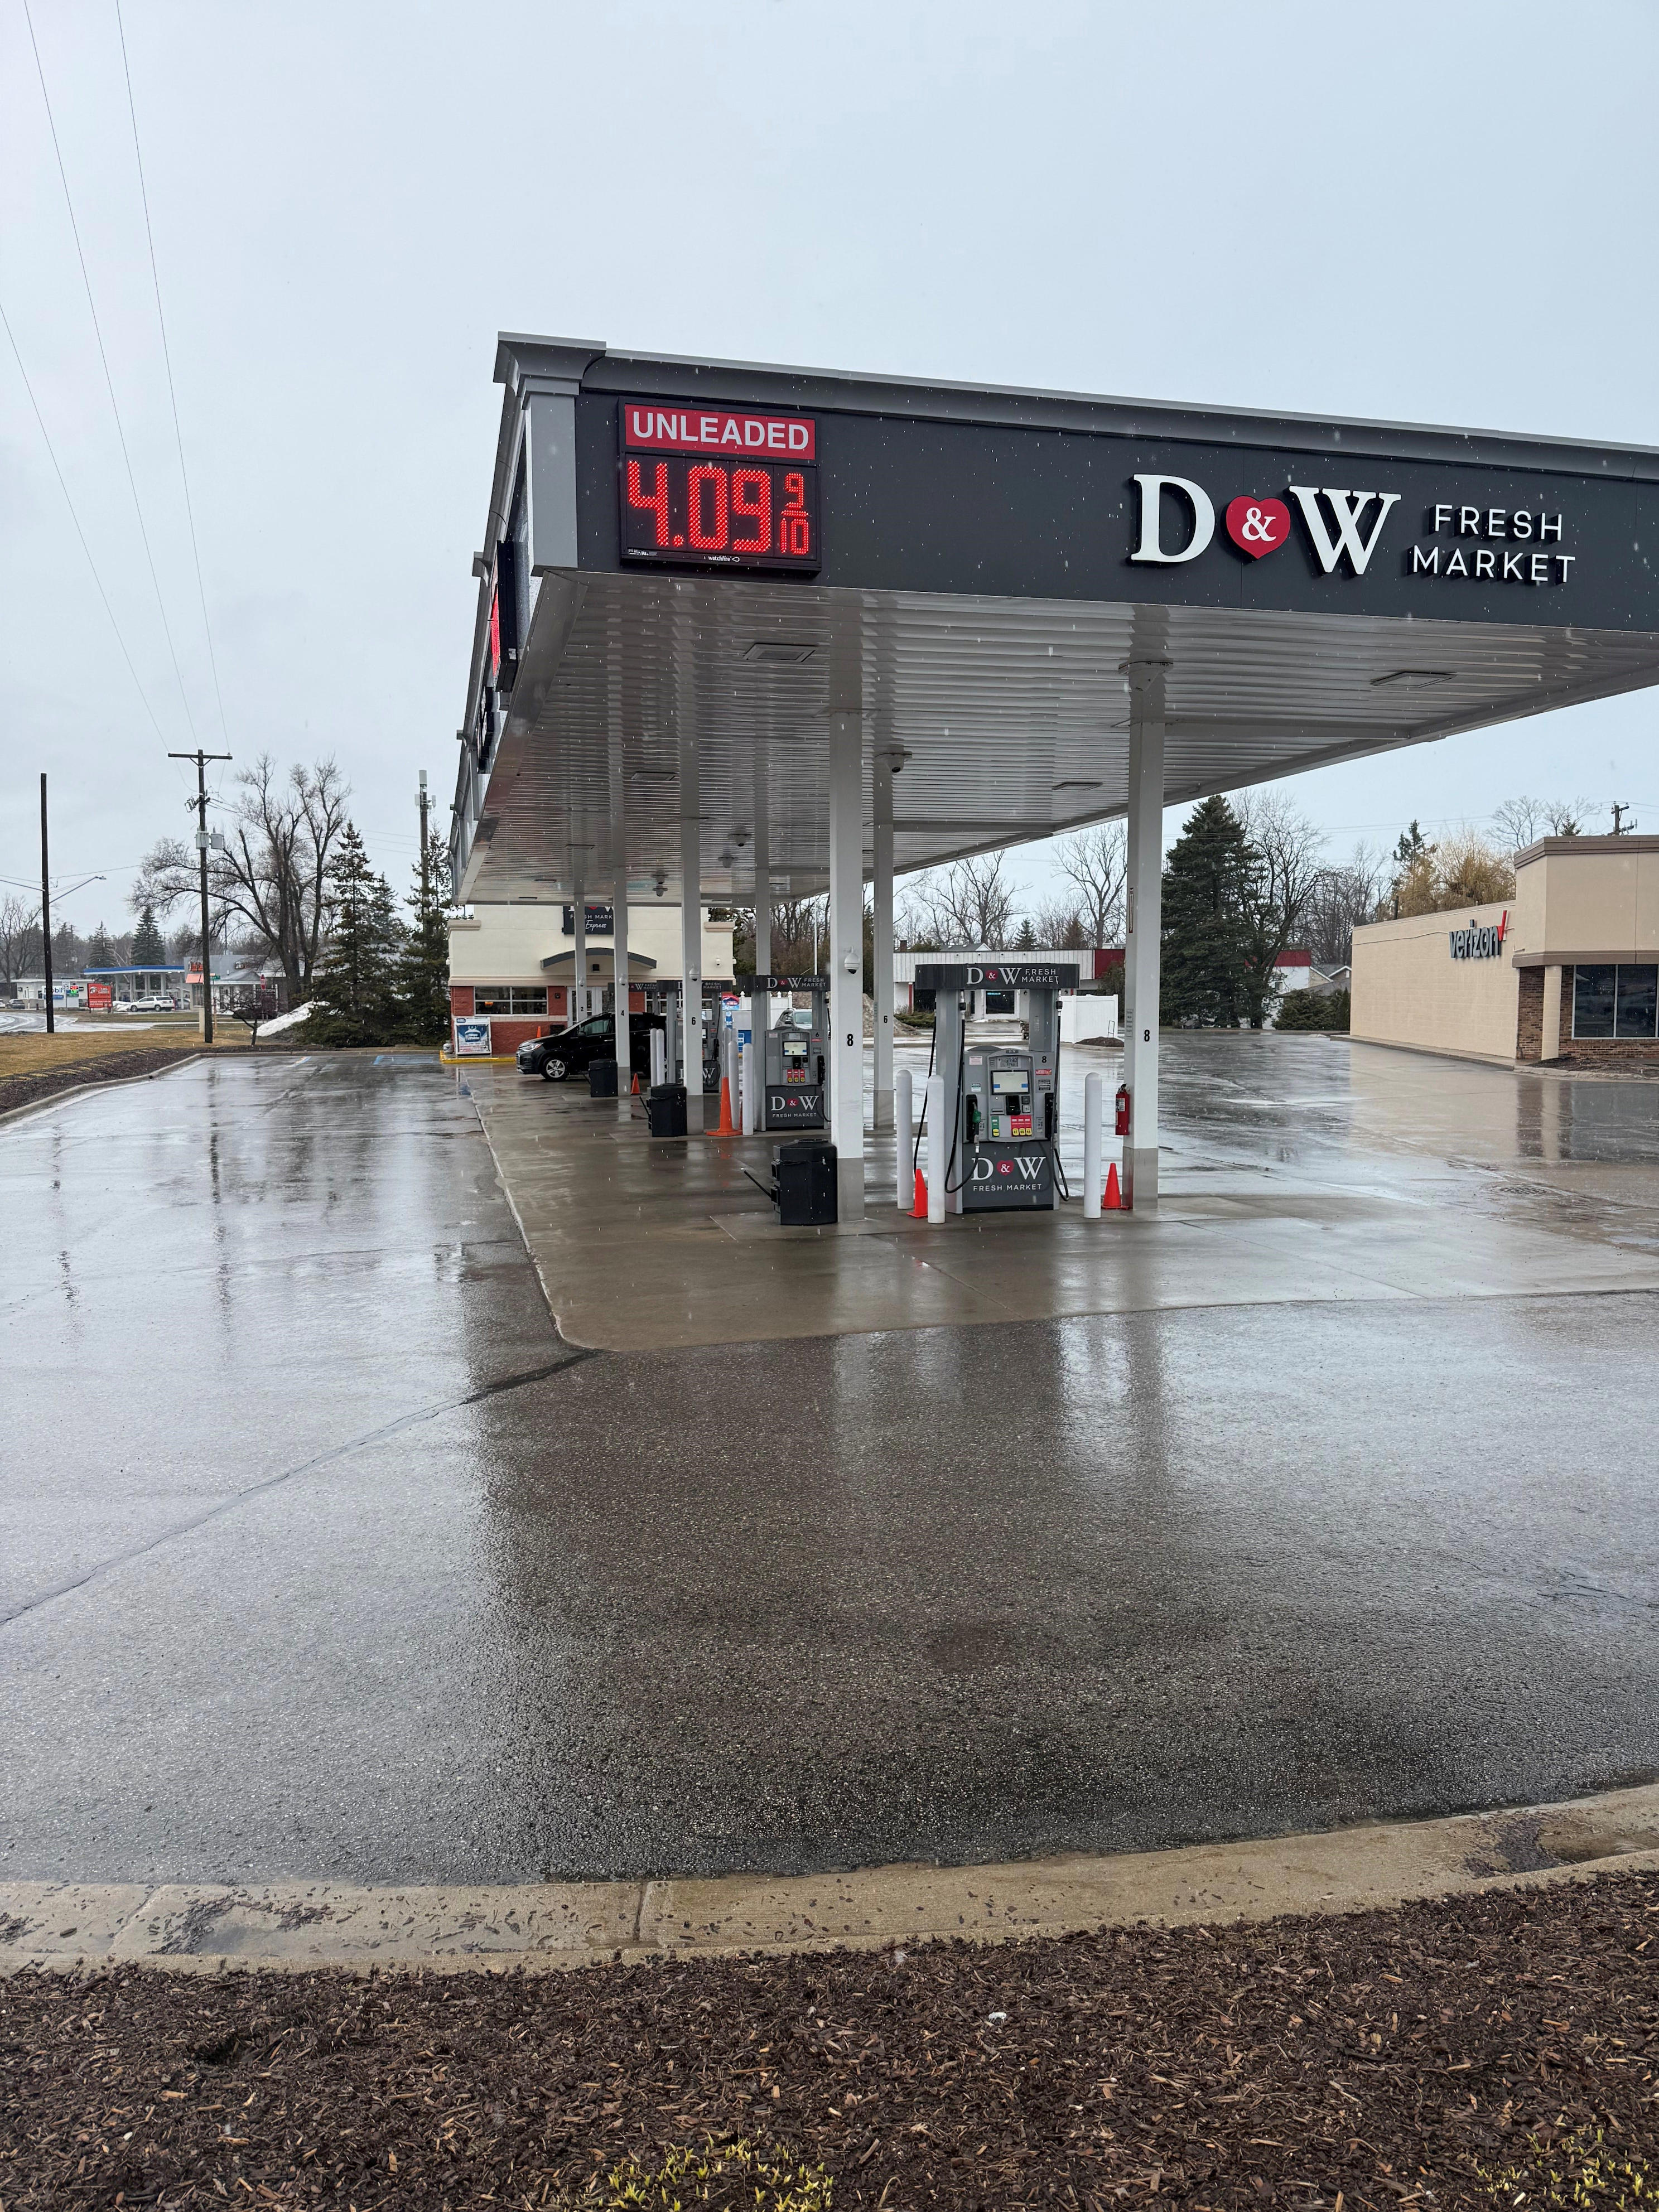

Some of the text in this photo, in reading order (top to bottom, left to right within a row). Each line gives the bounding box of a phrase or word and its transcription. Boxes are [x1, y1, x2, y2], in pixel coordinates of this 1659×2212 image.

[633, 411, 809, 450] UNLEADED
[627, 460, 772, 553] 4.09
[1435, 504, 1562, 541] FRESH
[1412, 545, 1576, 583] MARKET
[585, 919, 607, 931] Express
[1449, 919, 1502, 958] verizon
[692, 1017, 696, 1025] 6
[884, 1015, 888, 1023] 6
[847, 1033, 853, 1046] 8
[1144, 1029, 1150, 1042] 8
